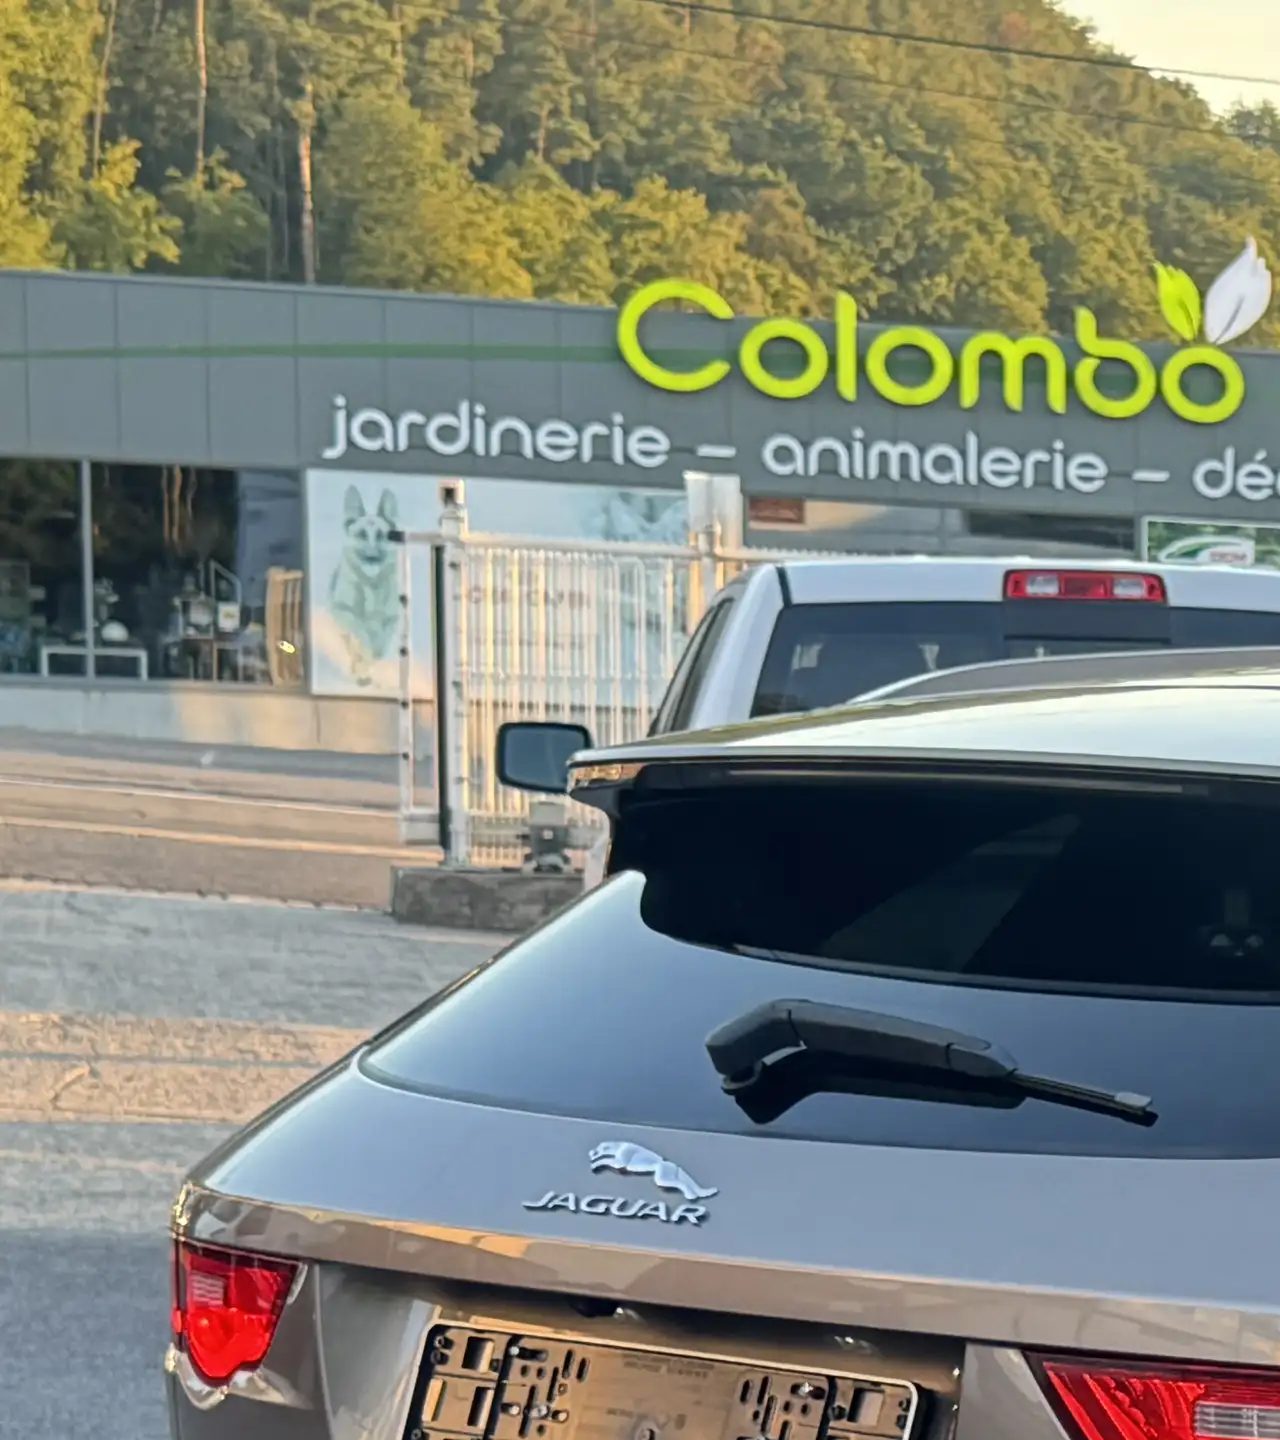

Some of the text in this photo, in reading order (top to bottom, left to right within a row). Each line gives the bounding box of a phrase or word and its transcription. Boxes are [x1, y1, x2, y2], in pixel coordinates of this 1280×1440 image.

[617, 278, 1246, 424] Colombo
[321, 393, 672, 468] jardinerie
[760, 426, 1108, 494] animalerie
[521, 1190, 707, 1225] JAGUAR
